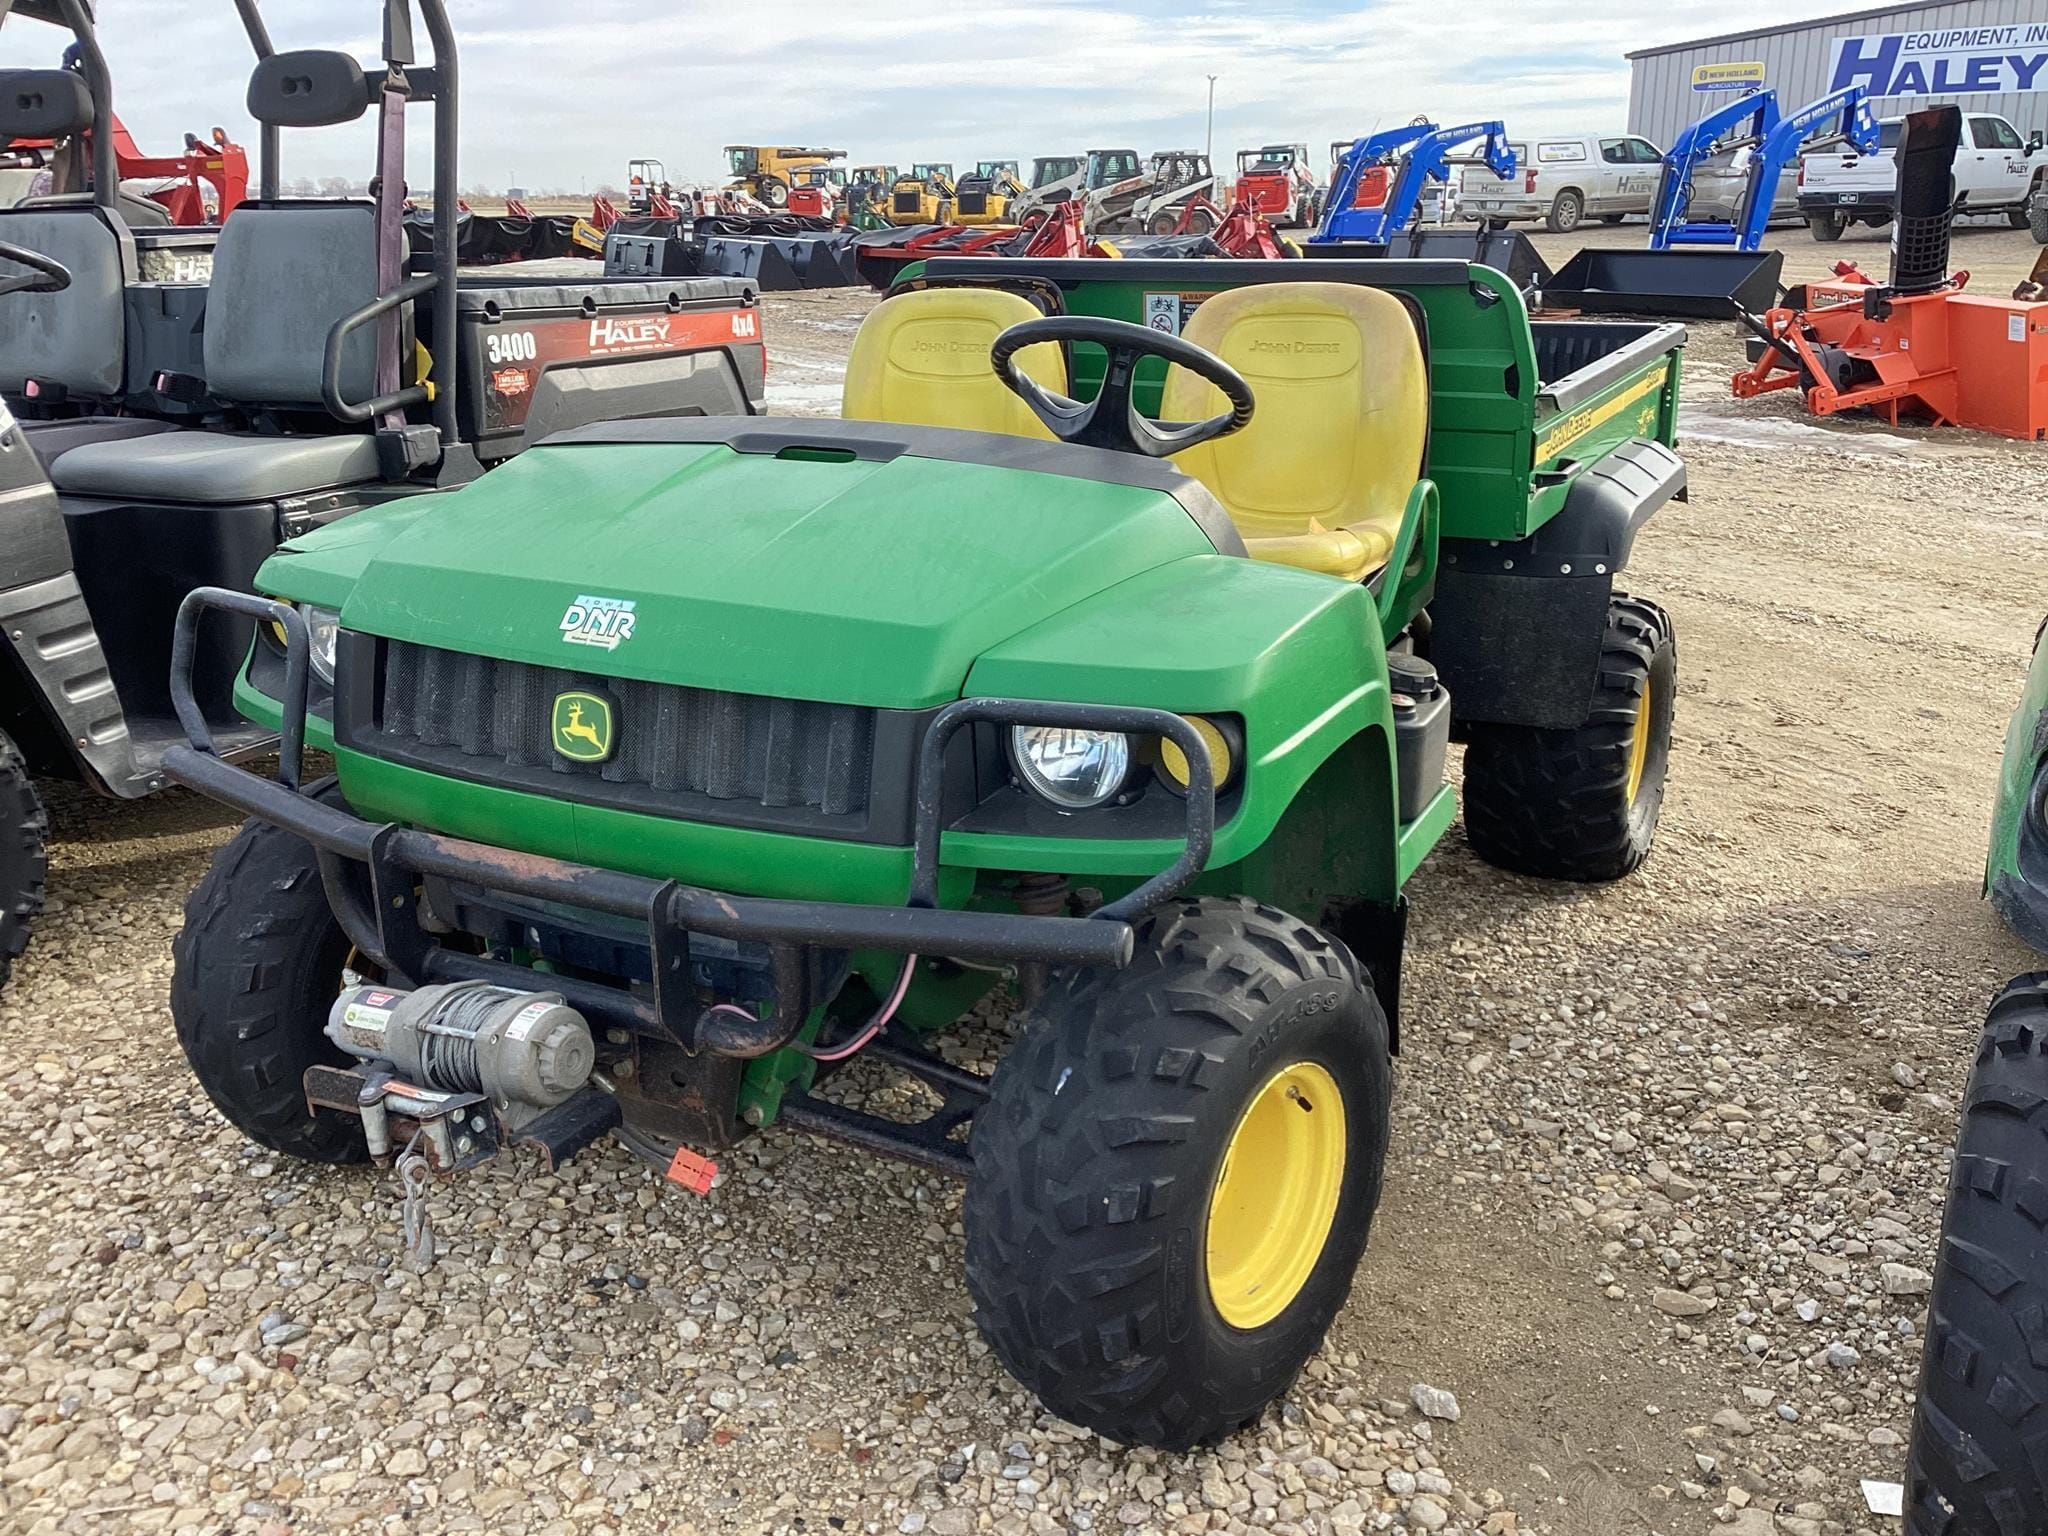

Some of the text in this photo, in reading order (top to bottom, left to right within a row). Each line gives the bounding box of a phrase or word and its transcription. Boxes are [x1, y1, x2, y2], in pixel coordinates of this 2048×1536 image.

[1904, 25, 2048, 50] EQUIPMENT, IN
[1709, 69, 1759, 79] NEW HOLLAND
[1830, 36, 2048, 96] HALEY
[1707, 81, 1746, 89] AGRICULTURE
[1793, 96, 1846, 130] NEW HOLLAND
[1436, 126, 1484, 141] NEW HOLLAND
[2006, 161, 2029, 174] HALEY
[1616, 175, 1653, 194] HALEY
[589, 318, 672, 348] HALEY
[614, 319, 655, 329] EQUIPMENT
[732, 313, 756, 337] 4x4
[487, 331, 537, 364] 3400
[911, 340, 989, 354] JOHN DEERE
[1248, 340, 1341, 354] JOHN DEERE
[1546, 408, 1592, 455] JOHN DEERE
[585, 599, 624, 609] IOWA
[558, 603, 637, 641] DNR
